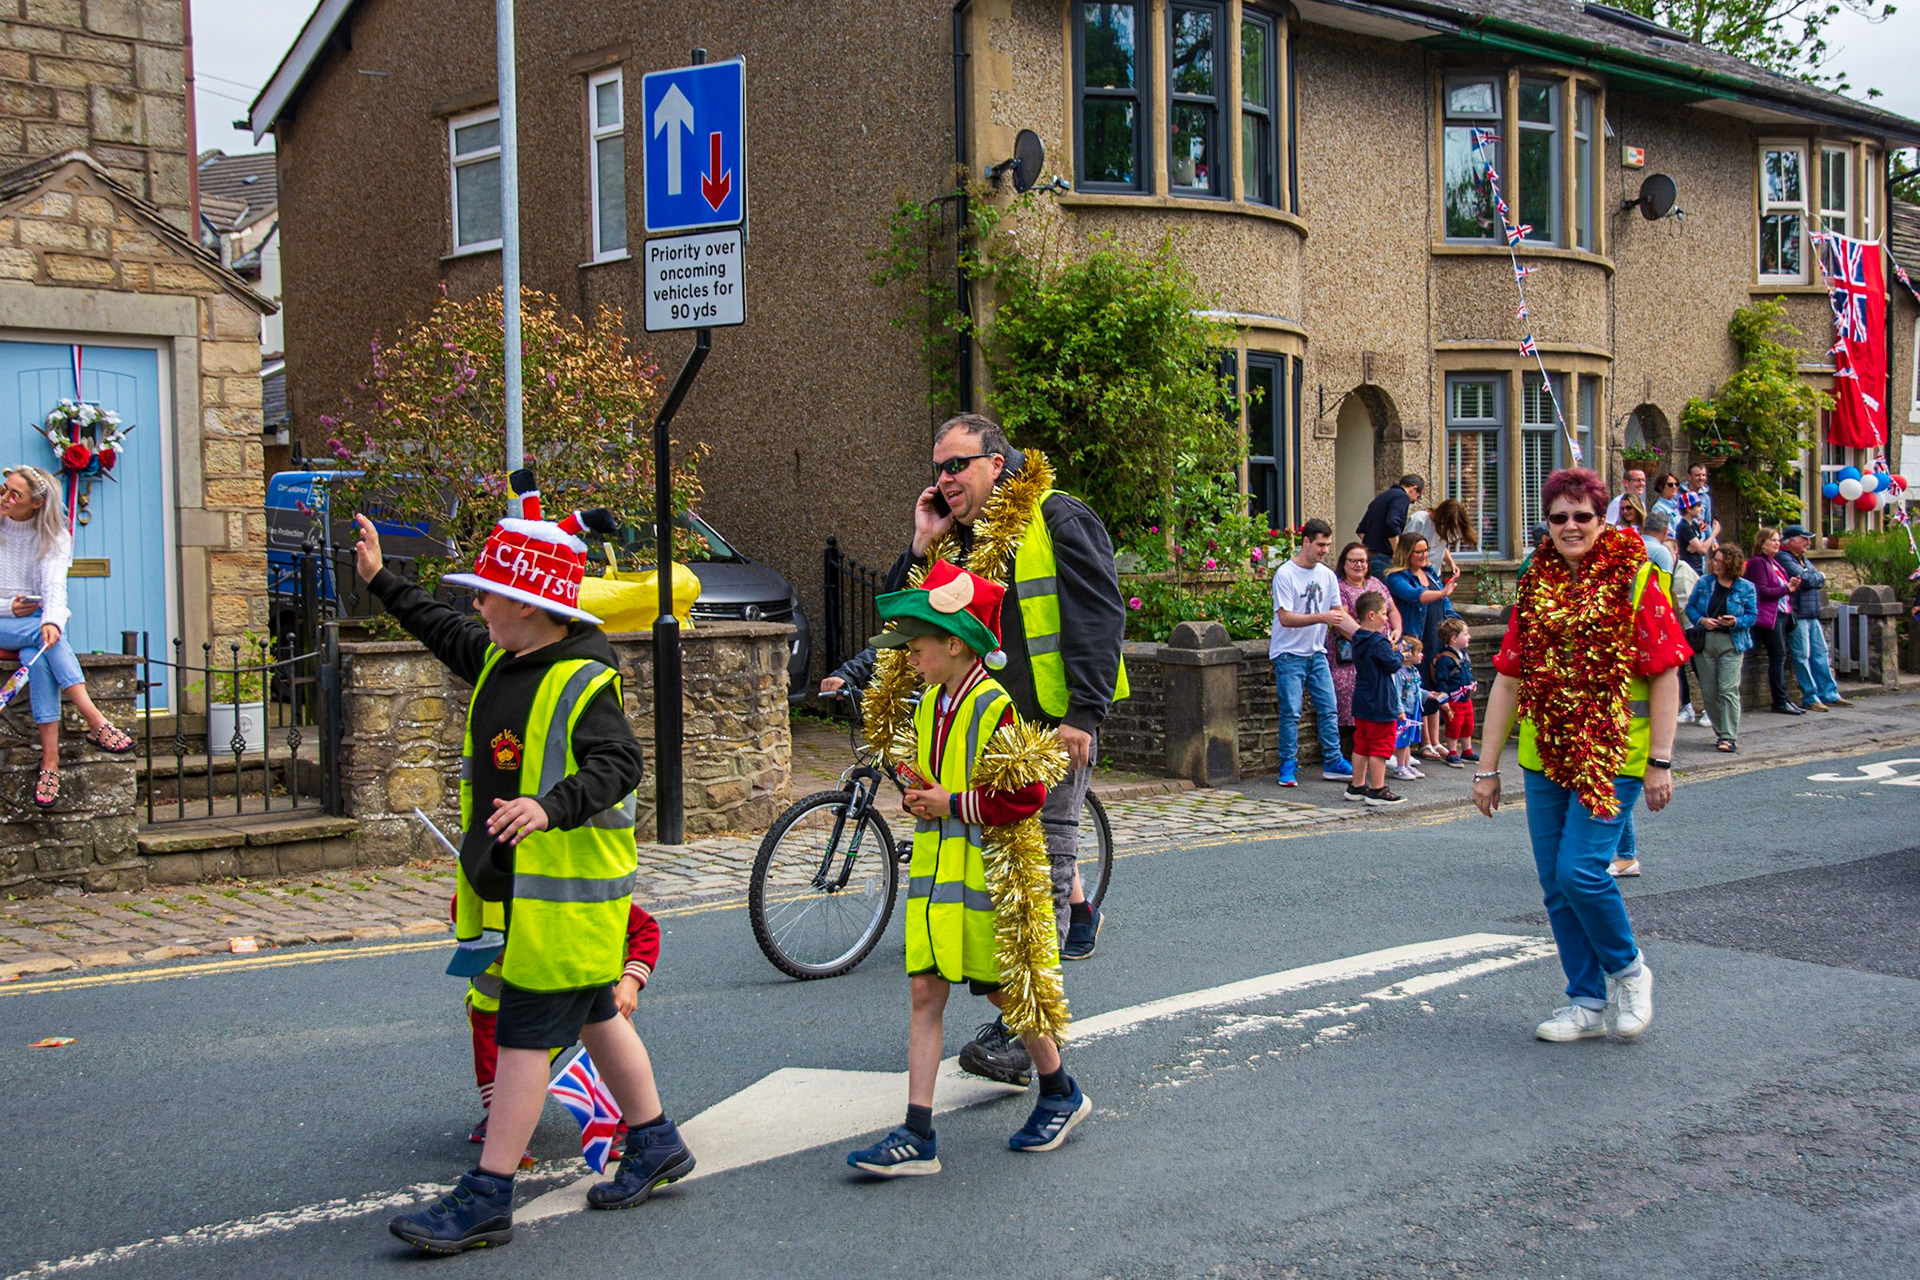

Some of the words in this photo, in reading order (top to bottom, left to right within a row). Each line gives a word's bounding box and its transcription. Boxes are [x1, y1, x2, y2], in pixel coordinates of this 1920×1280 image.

[651, 244, 701, 262] Priority
[706, 241, 736, 256] over
[660, 262, 726, 281] oncoming
[654, 283, 709, 301] vehicles
[713, 281, 734, 295] for
[671, 304, 690, 319] 90
[693, 302, 717, 320] yds
[490, 732, 503, 748] One
[503, 728, 524, 750] Voice
